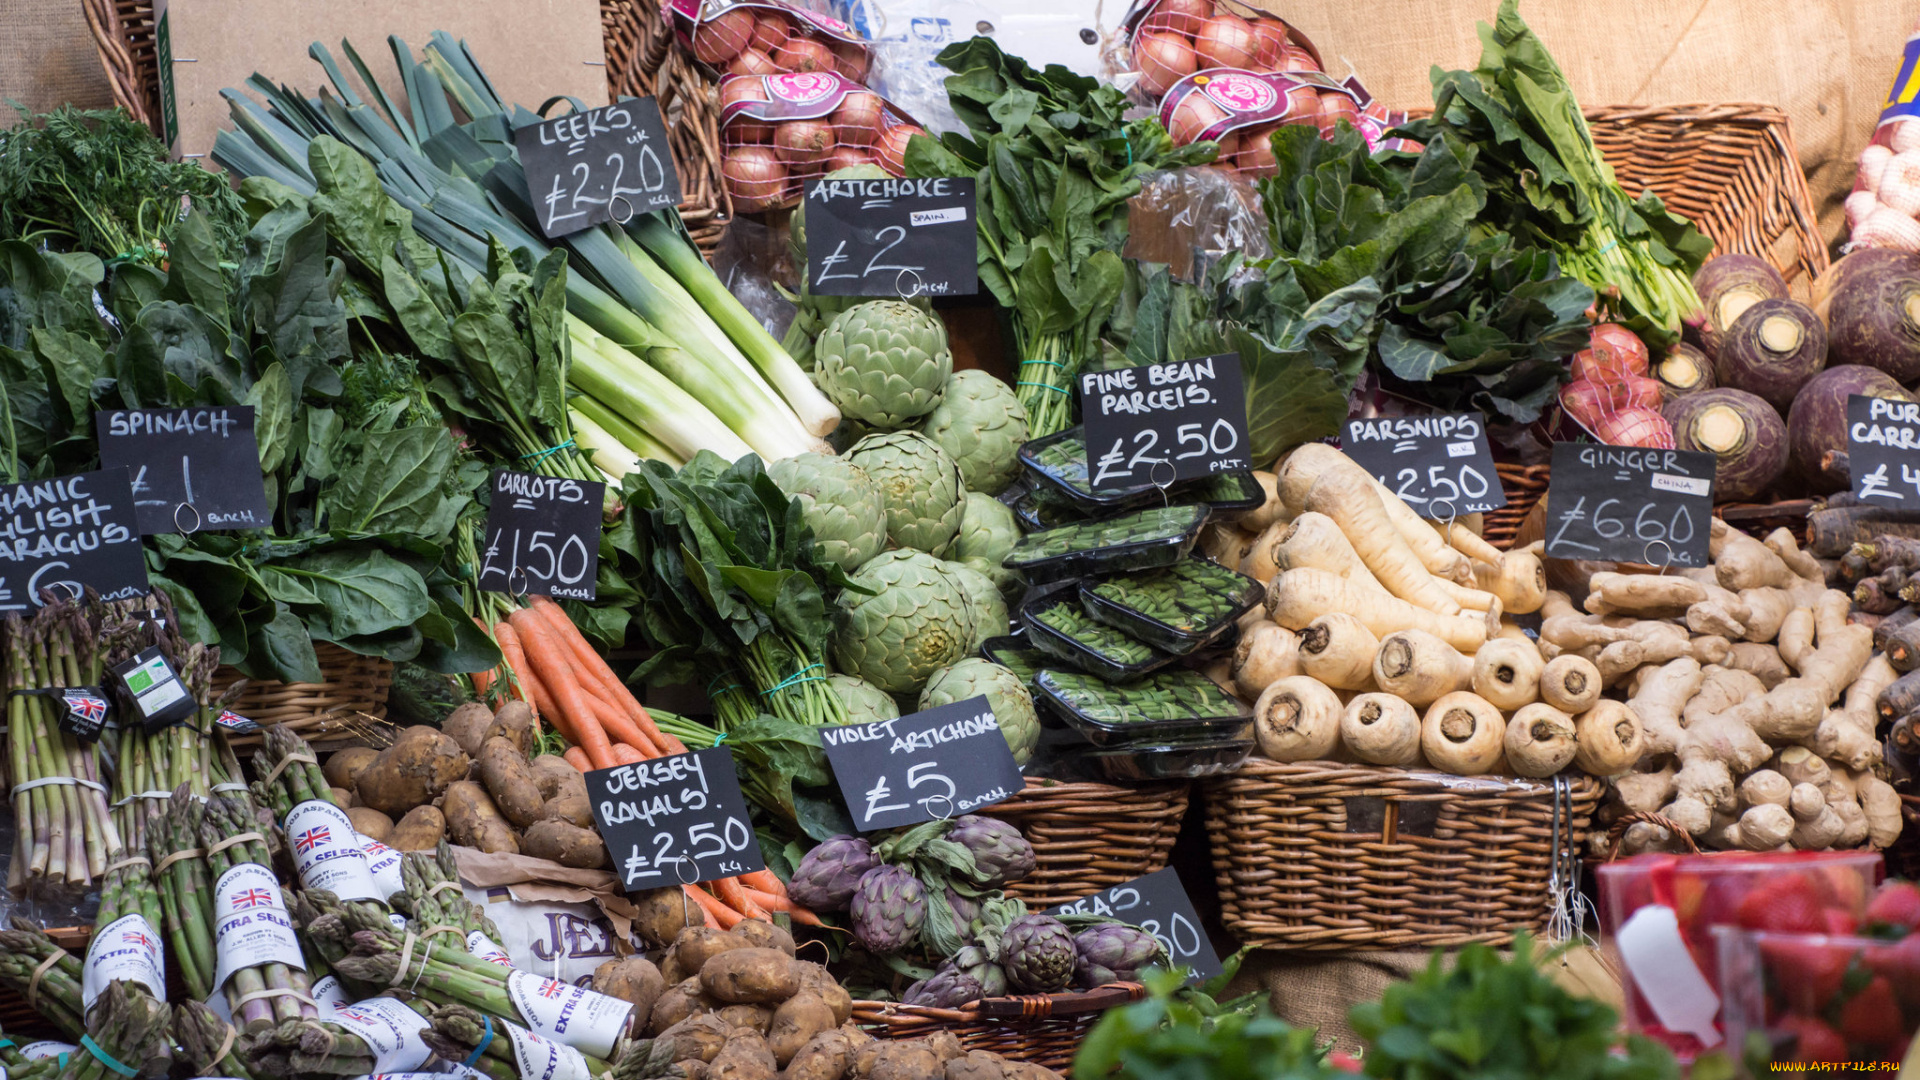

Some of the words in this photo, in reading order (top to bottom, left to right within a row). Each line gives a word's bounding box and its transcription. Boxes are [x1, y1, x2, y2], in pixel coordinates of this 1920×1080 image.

[539, 106, 637, 146] LEEKS.
[545, 143, 664, 230] £2.20
[816, 225, 926, 286] £2
[1082, 368, 1137, 395] FINE
[1148, 357, 1216, 385] BEAN
[109, 410, 237, 438] SPINACH
[1350, 415, 1480, 443] PARSNIPS
[1851, 421, 1920, 450] CARR
[1093, 417, 1238, 486] £2.50
[1210, 458, 1248, 473] PKT.
[1580, 448, 1690, 475] GINGER
[499, 472, 589, 504] CARROTS.
[1379, 463, 1489, 504] 2.50
[1657, 477, 1694, 491] CHINA
[1548, 496, 1694, 551] £6.60
[823, 717, 900, 746] VIOLET
[890, 712, 999, 754] ARTICHOKE
[606, 753, 709, 795] JERSEY
[864, 761, 957, 823] £5
[600, 787, 722, 827] ROYALS.
[624, 816, 750, 885] £2.50
[554, 999, 580, 1035] EXTRA
